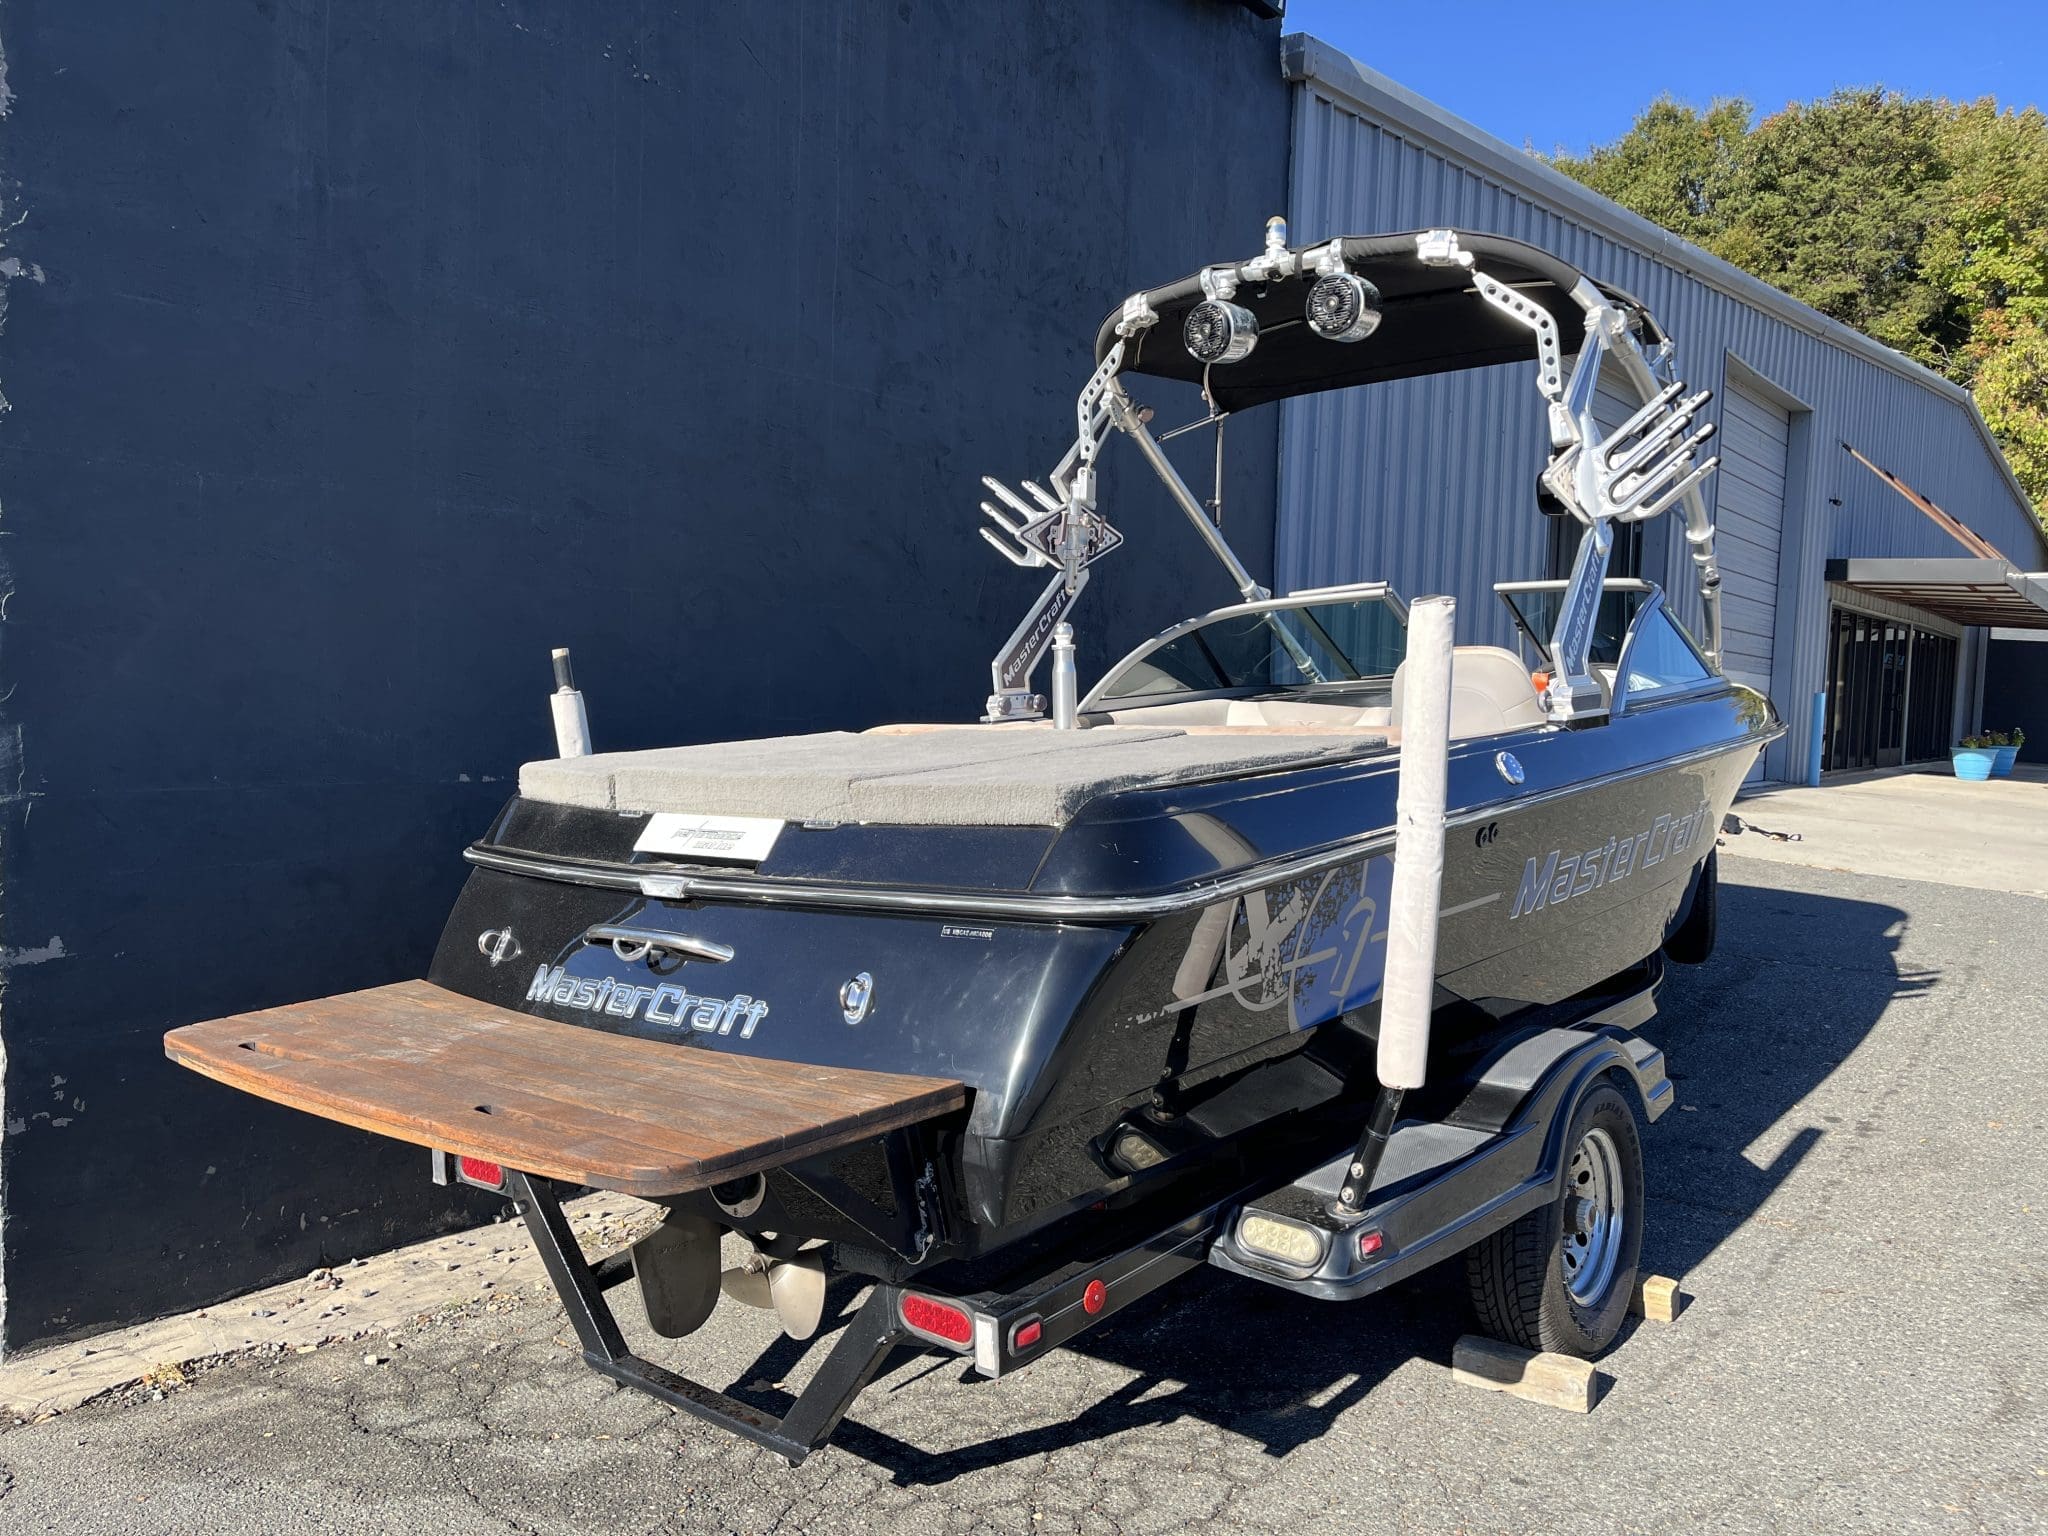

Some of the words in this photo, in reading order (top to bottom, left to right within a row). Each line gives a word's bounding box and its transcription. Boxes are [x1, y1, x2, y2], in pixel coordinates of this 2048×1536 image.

[1003, 589, 1067, 687] MasterCraft
[1566, 550, 1600, 674] MasterCraft
[1509, 799, 1713, 920] MasterCraft
[525, 963, 769, 1039] MasterCraft
